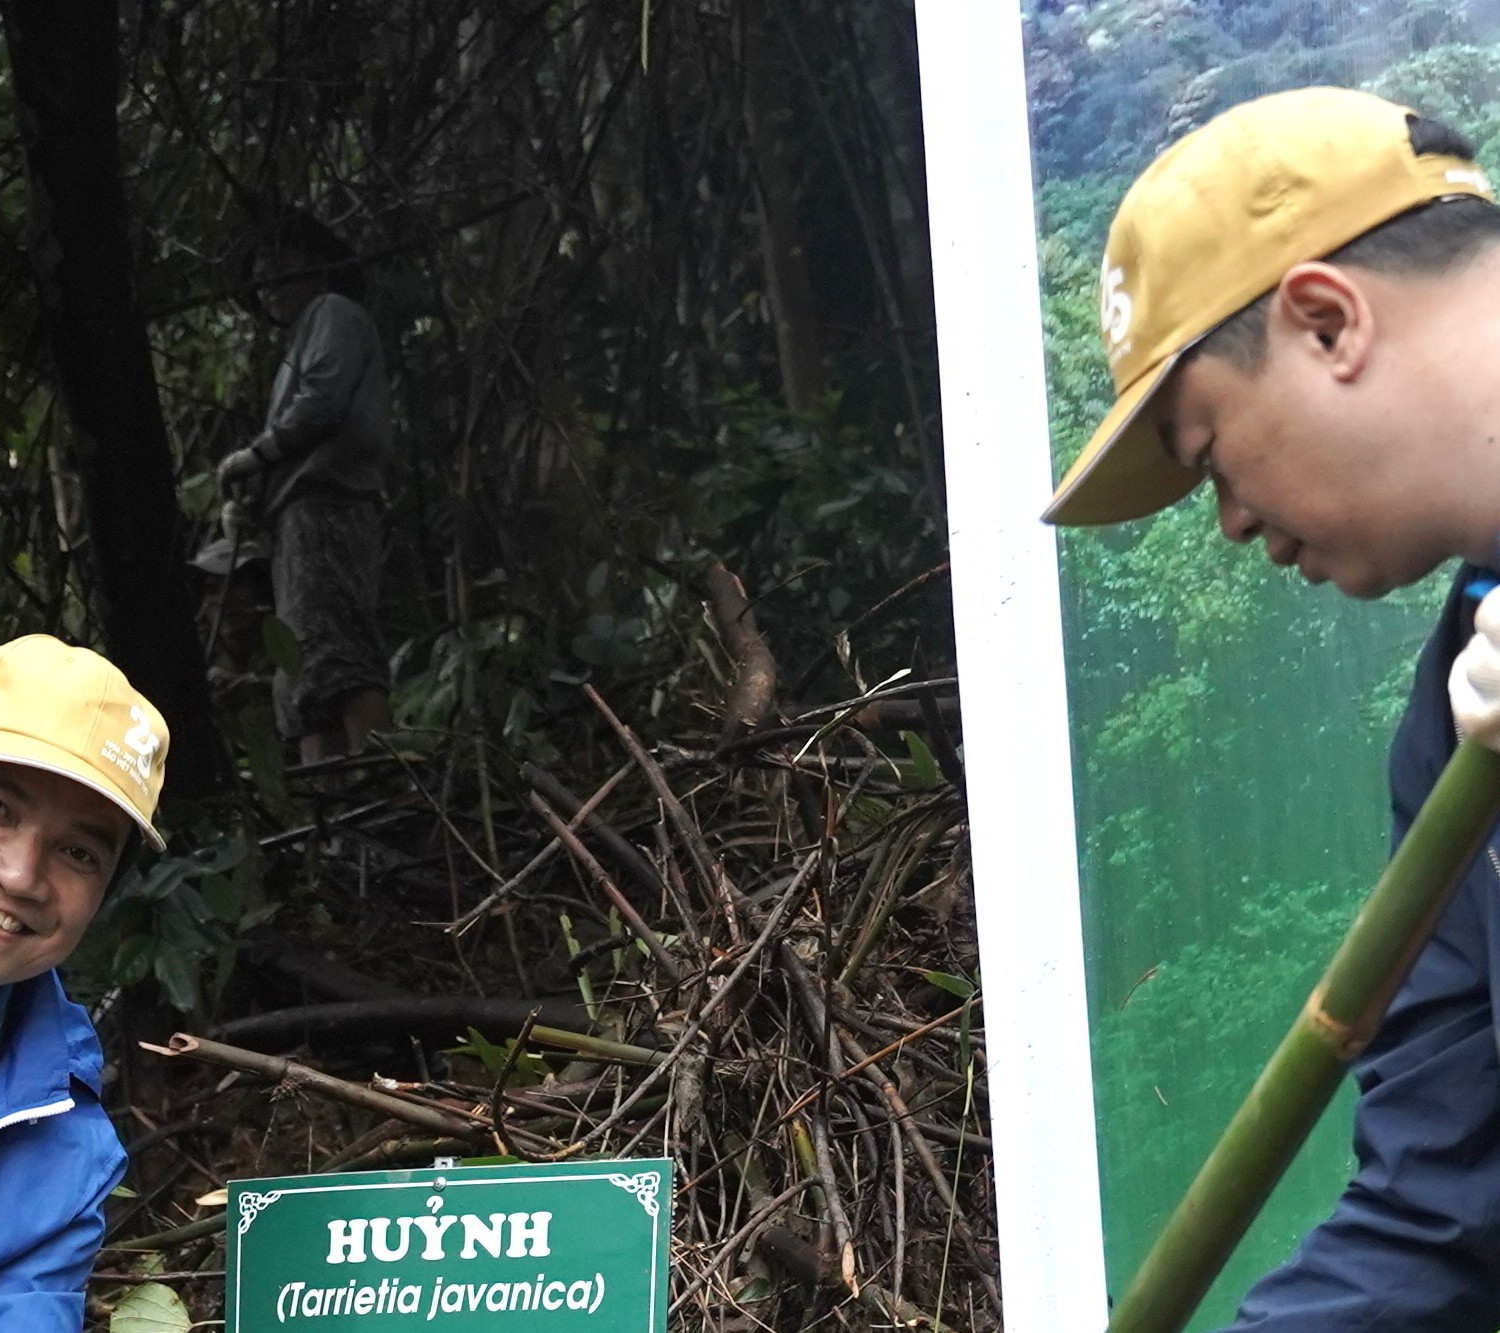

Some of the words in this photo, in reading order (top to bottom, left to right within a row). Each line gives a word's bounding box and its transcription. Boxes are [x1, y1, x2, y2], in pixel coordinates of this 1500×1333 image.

[325, 1195, 553, 1264] HUỶNH
[276, 1277, 420, 1323] (Tarrietia
[427, 1273, 606, 1321] javanica)
